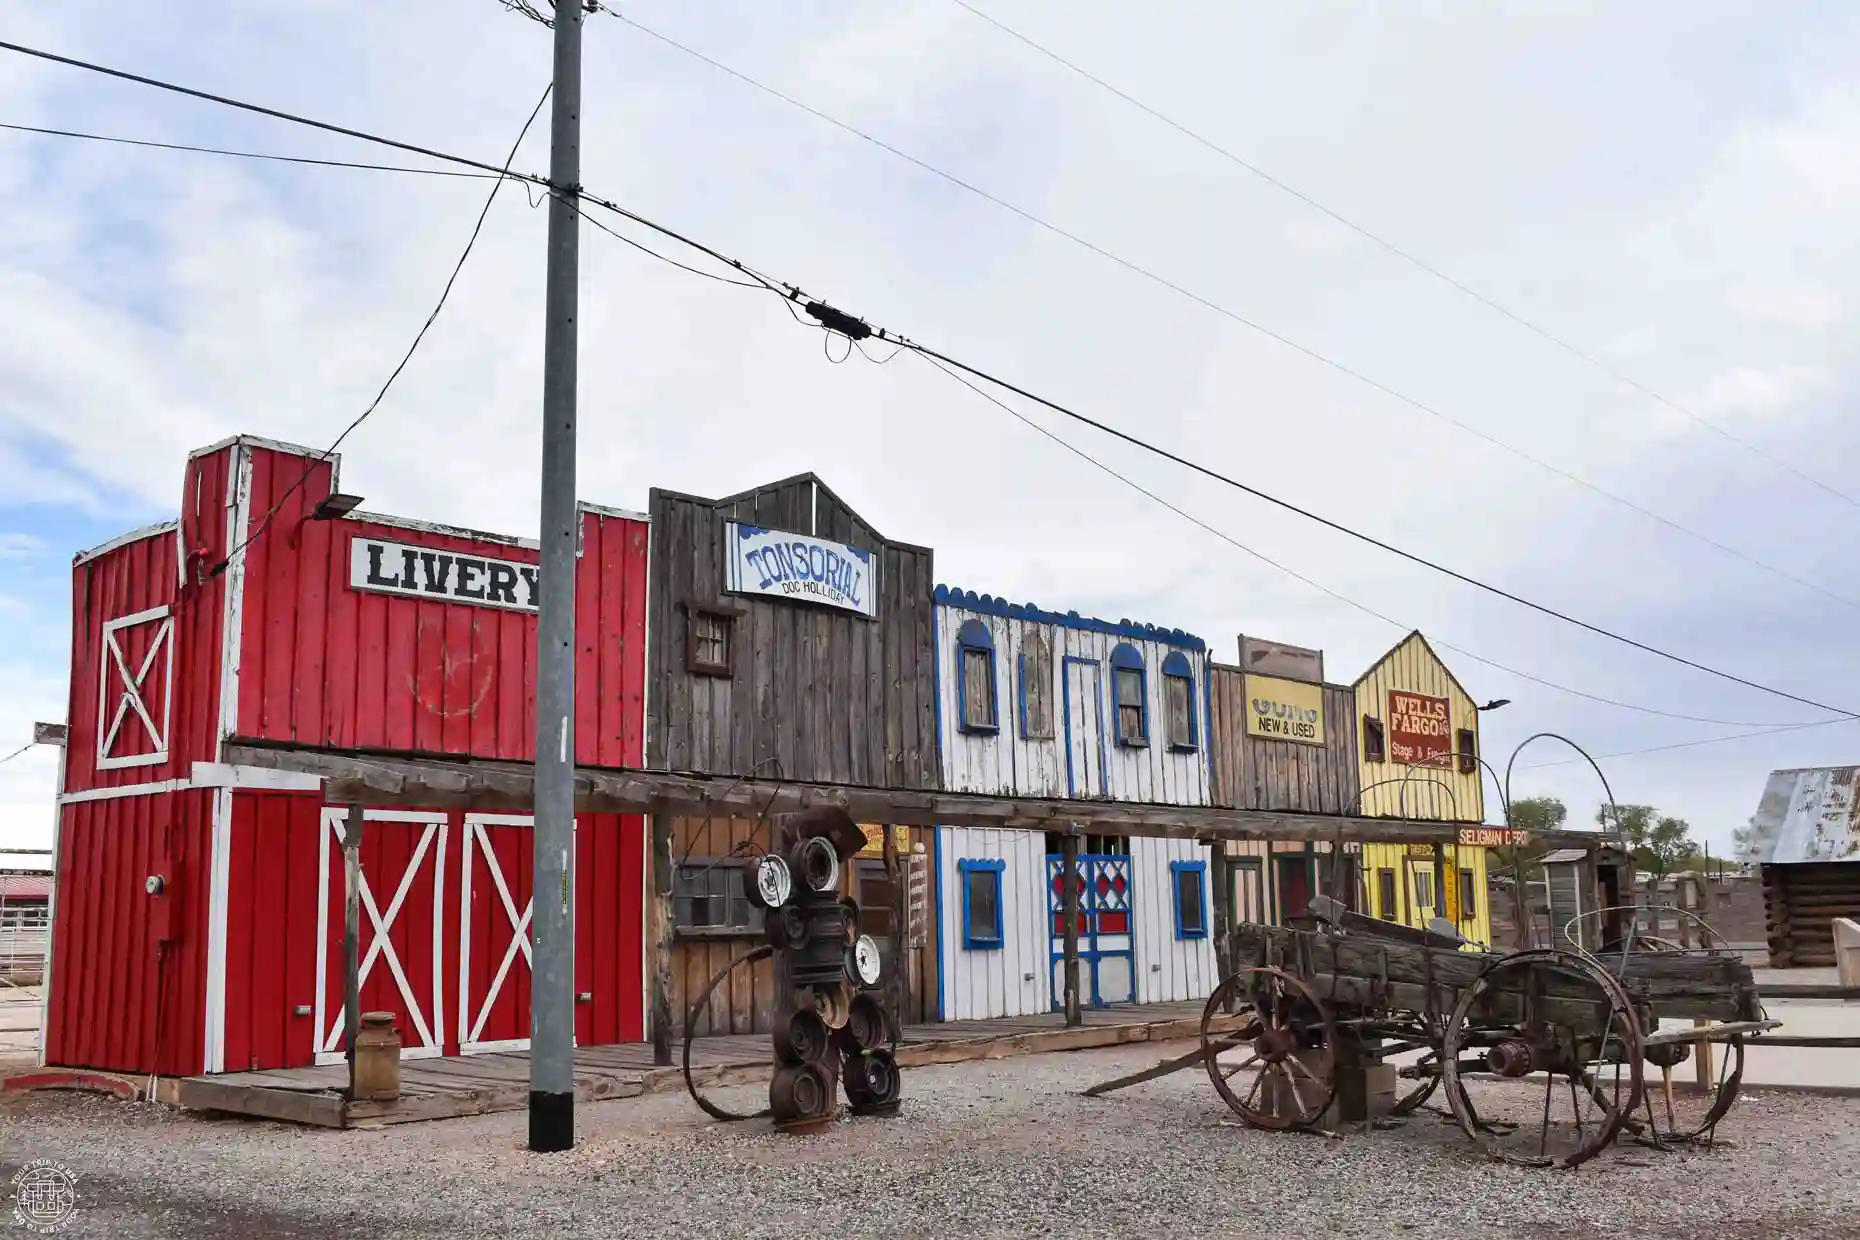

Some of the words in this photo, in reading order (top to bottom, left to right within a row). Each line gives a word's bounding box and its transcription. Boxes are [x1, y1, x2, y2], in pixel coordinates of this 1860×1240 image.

[367, 543, 540, 606] LIVERY
[745, 541, 861, 606] TONSORIAL
[781, 580, 801, 593] DOC
[803, 580, 845, 604] HOLLIDAY
[1395, 695, 1447, 720] WELLS
[1258, 717, 1281, 733] NEW
[1282, 720, 1290, 735] &
[1291, 722, 1316, 738] USED
[1391, 713, 1439, 737] FARGO
[1391, 741, 1414, 760] Stage
[1459, 828, 1502, 845] SELIGMAN
